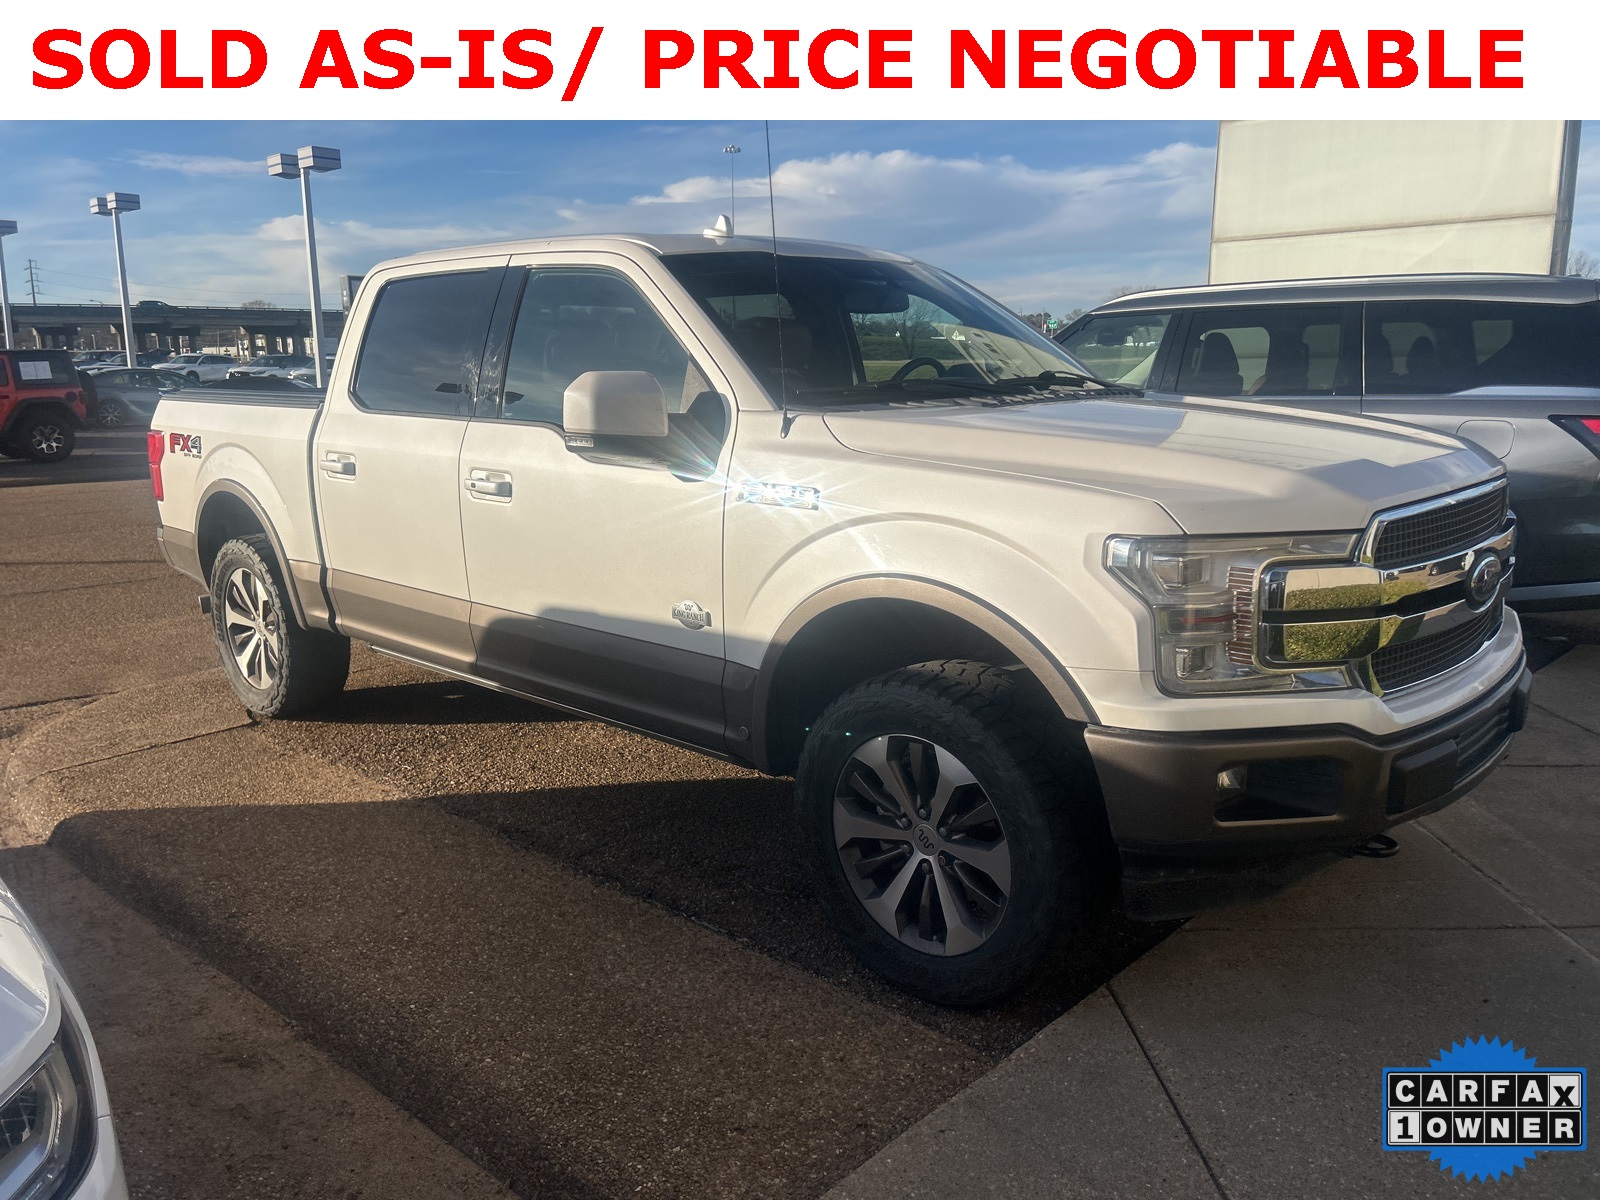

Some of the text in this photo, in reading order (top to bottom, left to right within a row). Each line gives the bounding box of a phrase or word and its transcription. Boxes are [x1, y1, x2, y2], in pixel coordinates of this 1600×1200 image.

[170, 432, 202, 454] FX4
[673, 609, 704, 622] KING RANCH
